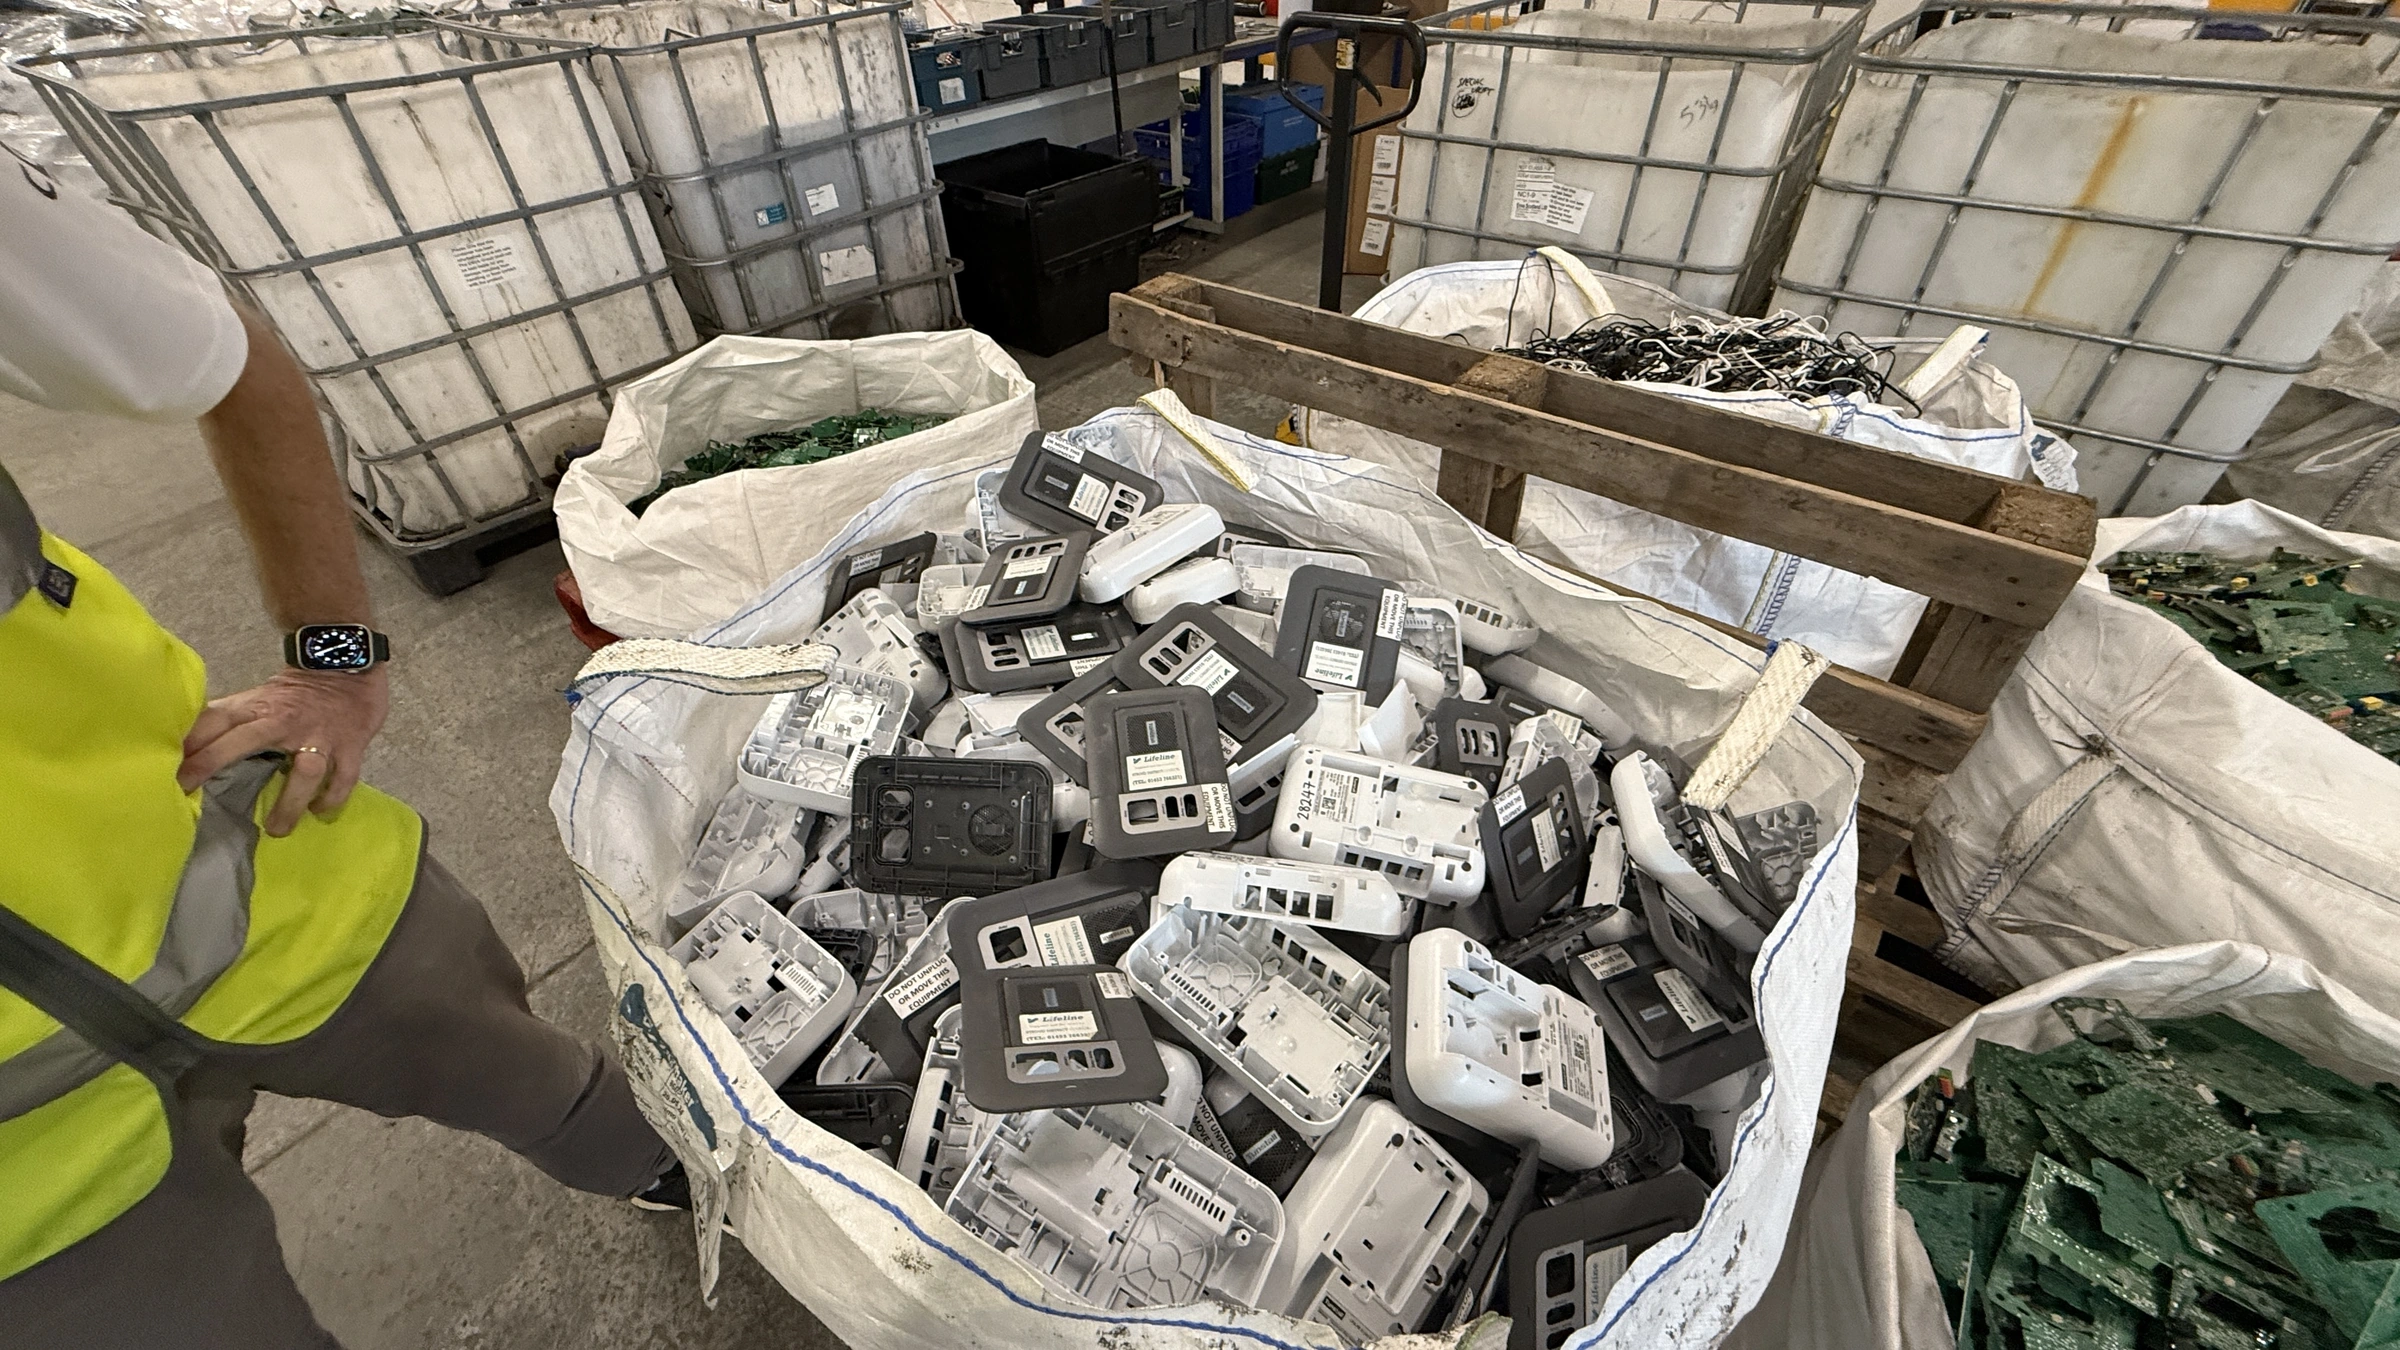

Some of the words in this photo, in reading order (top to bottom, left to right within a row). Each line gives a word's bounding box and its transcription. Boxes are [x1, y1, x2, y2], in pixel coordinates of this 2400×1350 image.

[1380, 595, 1390, 629] EQUIPMENT
[1394, 593, 1400, 604] OR
[1391, 604, 1399, 624] MOVE
[1387, 623, 1396, 634] THIS
[1314, 668, 1343, 680] Lifeline
[1144, 754, 1175, 762] Lifeline
[1211, 786, 1217, 796] OR
[1296, 781, 1316, 820] 28247
[1202, 792, 1215, 826] EQUIPMENT
[1213, 797, 1222, 816] MOVE
[1217, 816, 1226, 828] THIS
[1044, 932, 1059, 966] Lifeline
[1591, 961, 1599, 969] OR
[1599, 956, 1615, 966] MOVE
[888, 989, 900, 999] DO
[901, 977, 917, 991] NOT
[917, 957, 947, 979] UNPLUG
[898, 995, 911, 1005] OR
[910, 978, 934, 997] MOVE
[933, 967, 950, 981] THIS
[908, 978, 952, 1011] EQUIPMENT
[1663, 981, 1689, 1013] Lifeline
[1042, 1014, 1084, 1022] Lifeline
[1192, 1115, 1211, 1143] MOVE
[1200, 1104, 1214, 1123] NOT
[1210, 1123, 1234, 1160] UNPLUG
[1246, 1133, 1278, 1160] Tunstall
